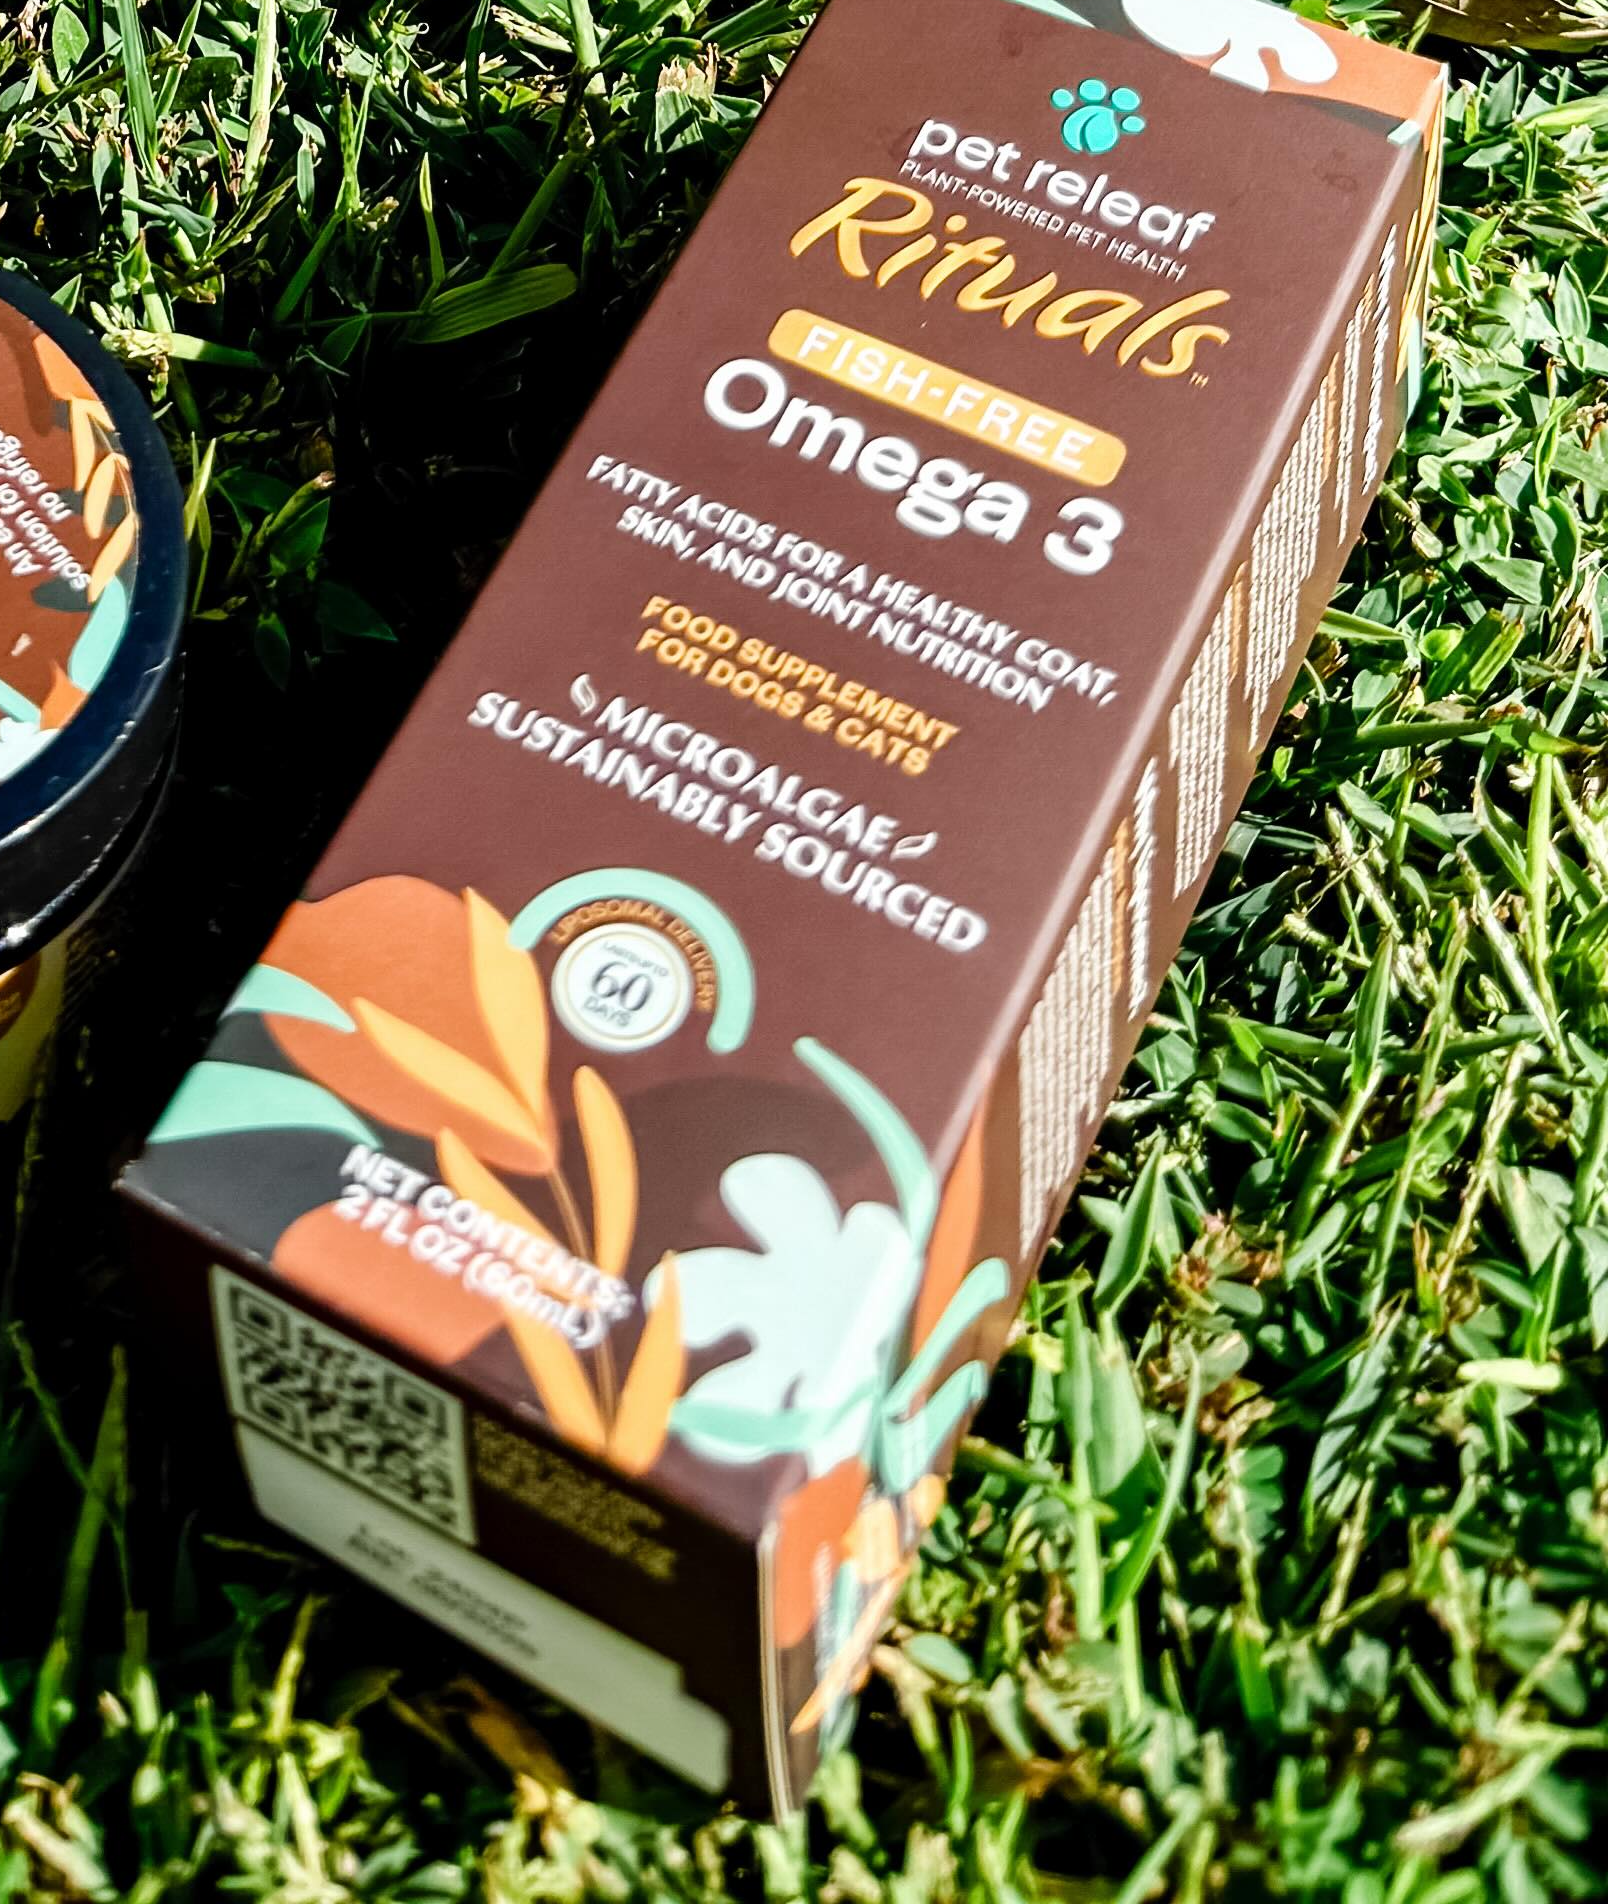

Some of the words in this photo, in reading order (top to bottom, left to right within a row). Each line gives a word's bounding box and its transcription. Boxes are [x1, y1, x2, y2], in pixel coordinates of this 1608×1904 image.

[899, 158, 1065, 234] PLANT-POWERED
[1066, 220, 1106, 251] PET
[1106, 238, 1188, 283] HEALTH
[908, 119, 1021, 183] pet
[1024, 157, 1216, 251] releaf
[703, 357, 1031, 545] Omega
[1043, 496, 1125, 575] 3
[798, 323, 1095, 472] FISH-FREE
[3, 542, 43, 576] An
[16, 510, 92, 592] solution
[37, 490, 73, 523] no
[587, 454, 681, 510] FATTY
[679, 492, 775, 551] ACIDS
[772, 533, 845, 580] FOR
[838, 563, 869, 592] A
[864, 573, 1019, 654] HEALTHY
[1013, 631, 1119, 709] COAT,
[616, 505, 697, 561] SKIN,
[697, 539, 777, 588] AND
[770, 569, 876, 631] JOINT
[870, 613, 1054, 713] NUTRITION
[635, 627, 709, 676] FOR
[705, 657, 803, 718] DOGS
[803, 703, 835, 734] &
[834, 716, 935, 777] CATS
[640, 595, 738, 651] FOOD
[740, 635, 960, 749] SUPPLEMENT
[466, 692, 765, 845] SUSTAINABLY
[754, 820, 990, 954] SOURCED
[594, 695, 899, 857] MICROALGAE
[551, 899, 666, 943] LIPOSOMAL
[592, 962, 653, 1012] 60
[582, 996, 633, 1027] DAYS
[334, 1184, 371, 1220] 2
[361, 1197, 411, 1246] FL
[408, 1224, 472, 1275] OZ
[340, 1144, 429, 1201] NET
[417, 1185, 637, 1319] CONTENTS:
